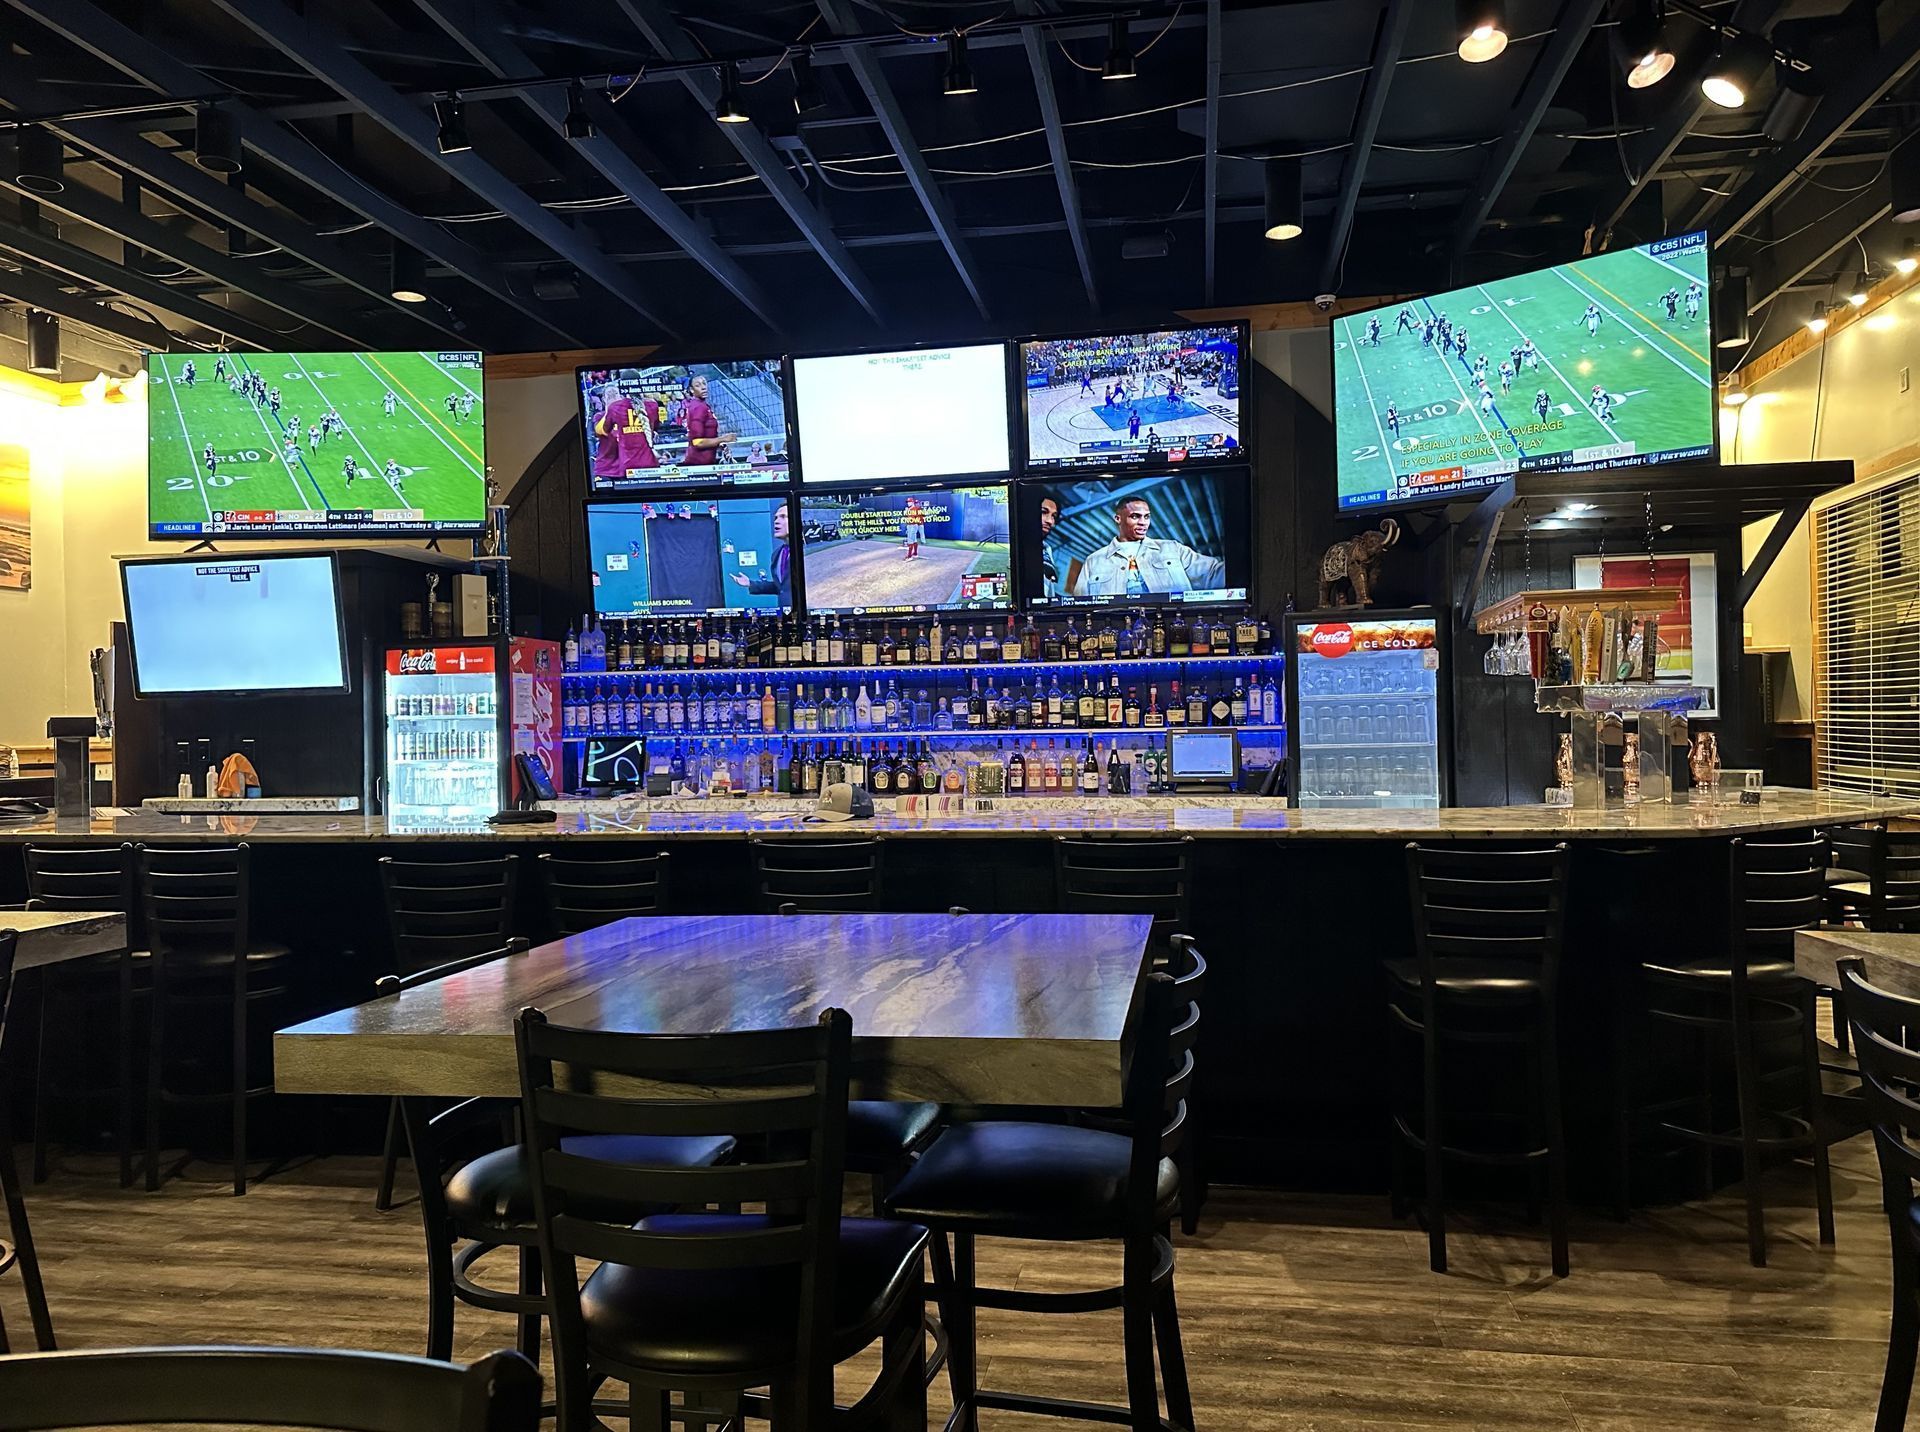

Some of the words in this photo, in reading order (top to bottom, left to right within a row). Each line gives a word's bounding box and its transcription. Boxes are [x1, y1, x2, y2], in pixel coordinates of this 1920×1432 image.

[1660, 240, 1678, 251] CBS
[1683, 235, 1702, 246] NFL
[1661, 252, 1678, 260] 2022
[1682, 246, 1700, 256] Week
[1413, 413, 1424, 421] &
[1422, 404, 1448, 418] 10
[1401, 437, 1457, 455] ESPECIALLY
[1460, 435, 1472, 444] IN
[1474, 430, 1502, 444] ZONE
[1504, 420, 1566, 437] COVERAGE.
[236, 450, 260, 462] 10
[1401, 459, 1410, 468] IF
[1412, 455, 1434, 466] YOU
[1438, 451, 1456, 462] ARE
[1460, 446, 1495, 460] GOING
[1499, 442, 1514, 452] TO
[1517, 438, 1545, 450] PLAY
[1660, 448, 1709, 461] NETWORK
[1423, 474, 1436, 482] CIN
[1451, 470, 1460, 478] 21
[1539, 456, 1560, 466] 12:21
[1584, 450, 1598, 458] 1ST
[1610, 448, 1622, 456] 10
[1349, 493, 1381, 503] HEADLINES
[1420, 485, 1438, 494] Jarvis
[1439, 482, 1462, 492] Landry
[1608, 458, 1641, 468] Thursday
[163, 523, 196, 531] HEADLINES
[252, 524, 272, 532] Landry
[400, 522, 427, 530] Thursday
[992, 601, 1008, 609] FOX
[1313, 630, 1352, 644] Coca-Cola
[1586, 618, 1599, 646] Shiner
[1384, 640, 1417, 648] COLD
[1109, 704, 1121, 721] 7
